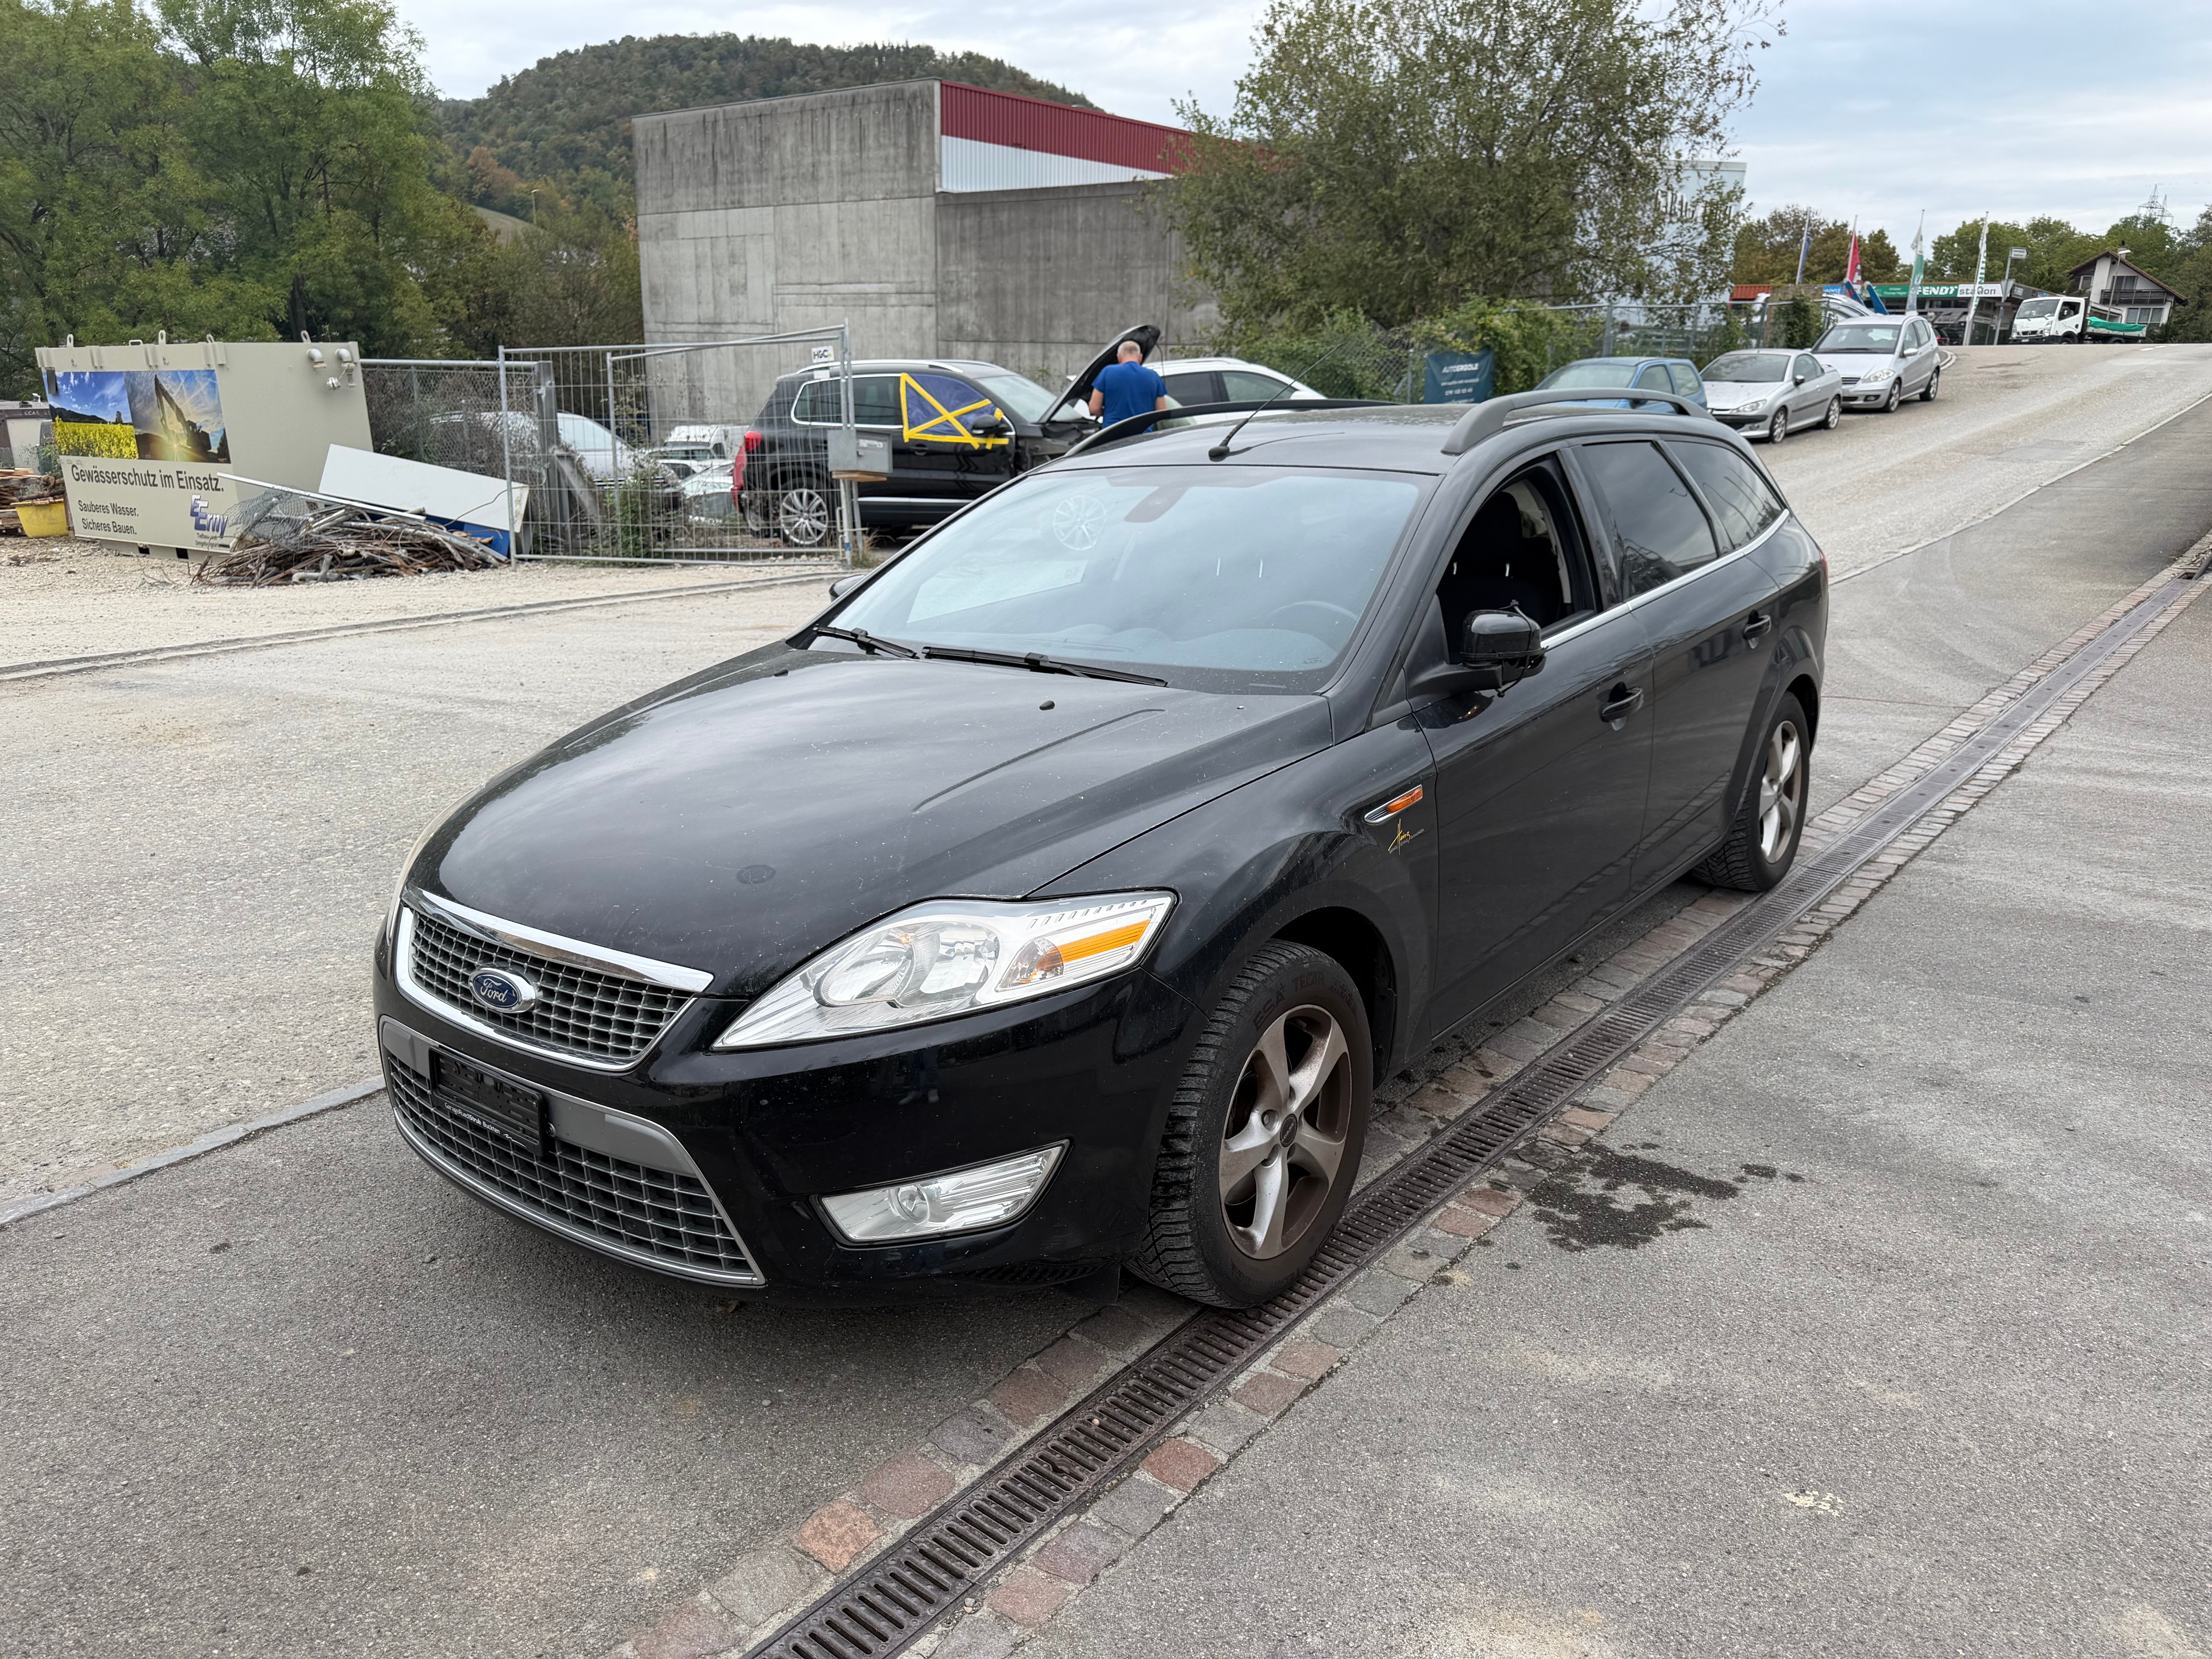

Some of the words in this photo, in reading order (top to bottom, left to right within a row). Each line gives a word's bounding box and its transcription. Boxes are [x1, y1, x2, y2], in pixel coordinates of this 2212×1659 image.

[1960, 287, 1996, 295] staion
[71, 464, 158, 487] Gewässerschutz
[159, 469, 174, 488] im
[176, 470, 224, 491] Einsatz.
[78, 500, 110, 514] Sauberes
[110, 502, 139, 517] Wasser.
[82, 518, 111, 532] Sicheres
[112, 520, 137, 535] Bauen.
[480, 978, 508, 1003] Ford
[483, 1121, 501, 1135] Buckten
